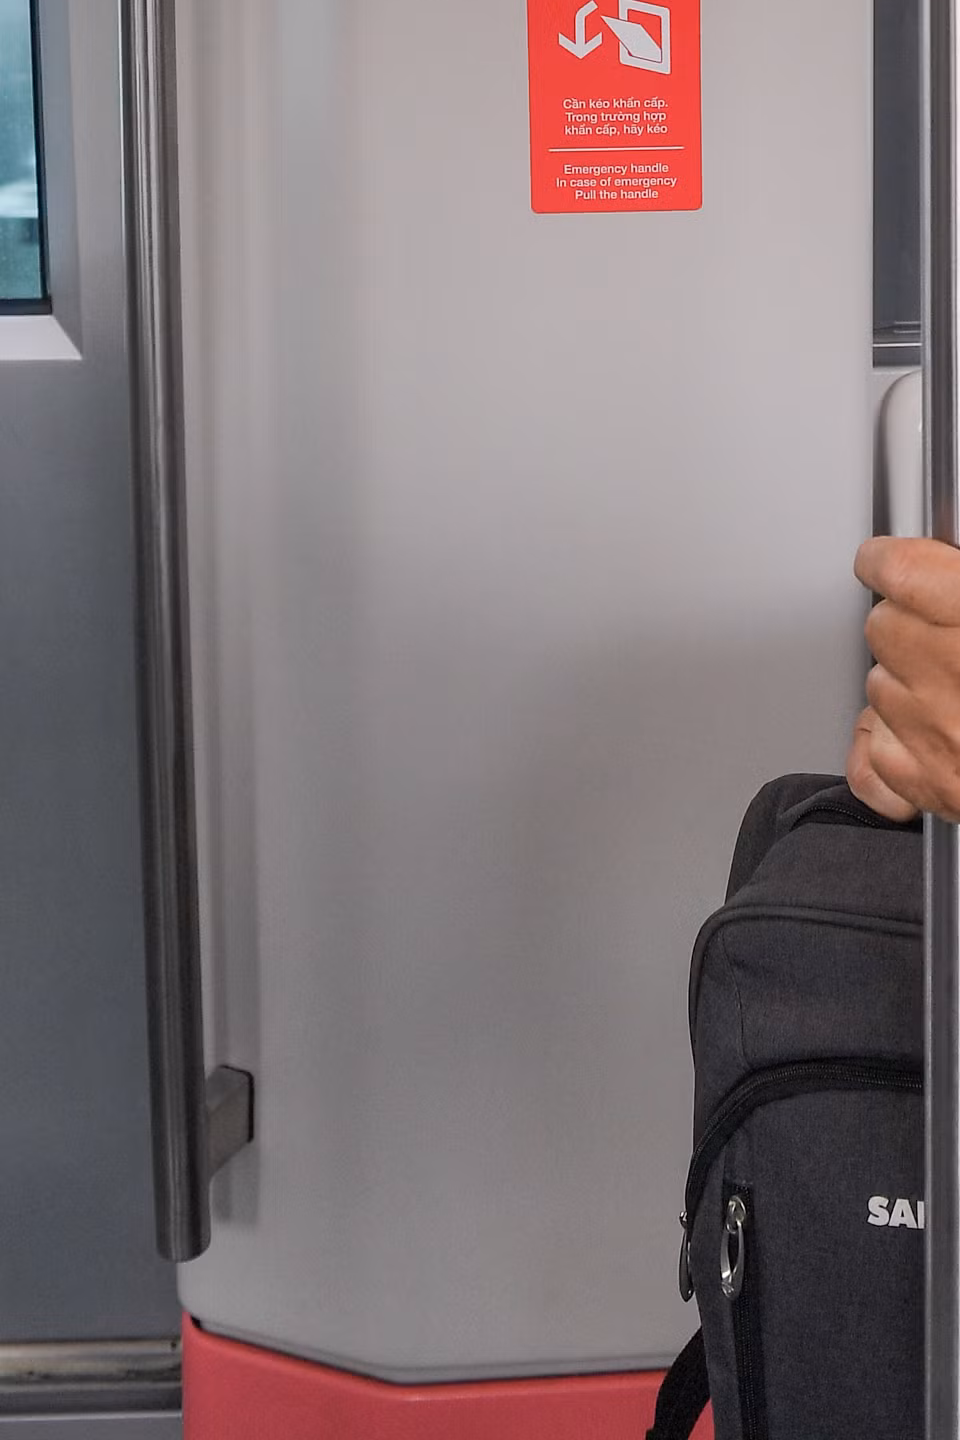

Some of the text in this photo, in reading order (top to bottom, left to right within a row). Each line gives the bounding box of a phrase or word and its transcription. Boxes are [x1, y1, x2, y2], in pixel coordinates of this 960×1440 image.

[589, 98, 610, 109] kéo
[565, 112, 598, 124] Trong
[643, 111, 666, 122] hợp
[647, 123, 668, 134] kéo
[564, 162, 669, 176] Emergency handle
[556, 176, 677, 189] In case of emergency
[575, 188, 659, 200] Pull the handle
